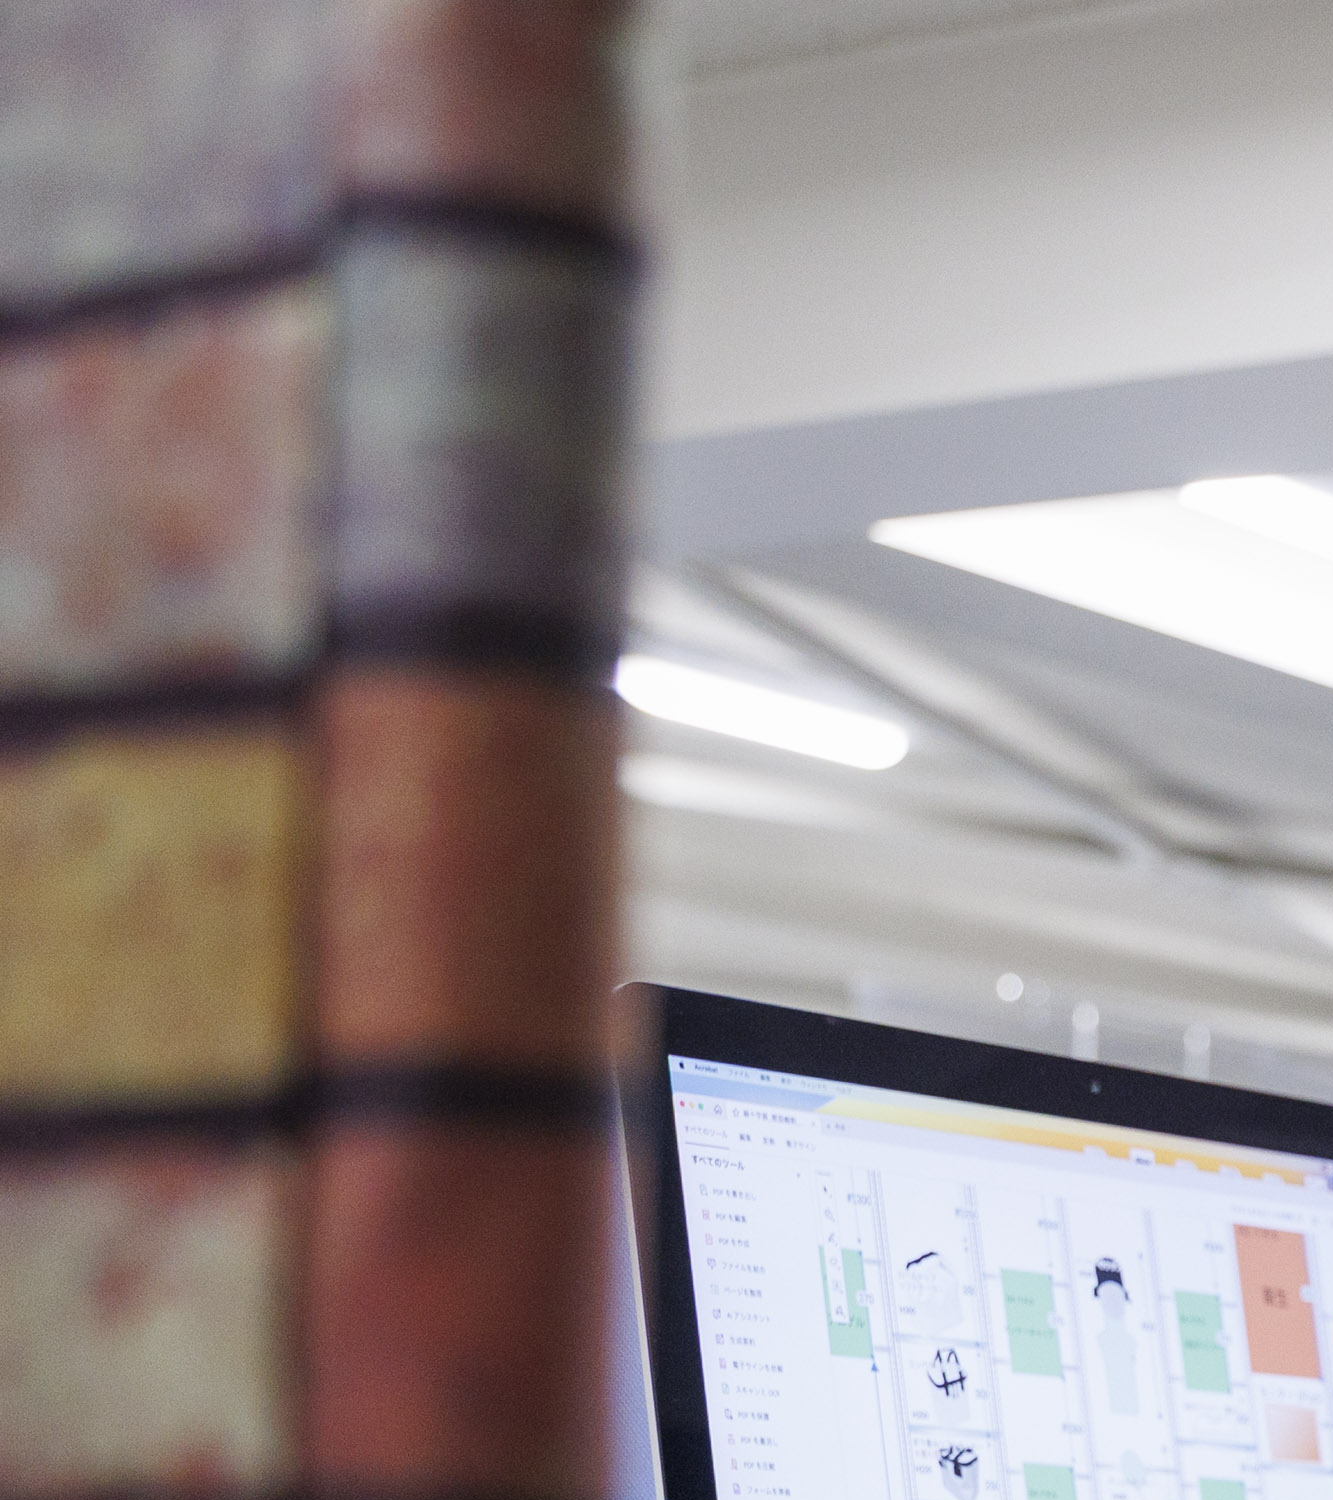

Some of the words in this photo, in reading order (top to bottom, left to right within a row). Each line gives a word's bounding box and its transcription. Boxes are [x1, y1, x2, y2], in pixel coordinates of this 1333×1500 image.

[694, 1064, 717, 1073] Acrobat
[684, 1125, 727, 1139] すべてのツール
[692, 1155, 744, 1171] すべてのツール
